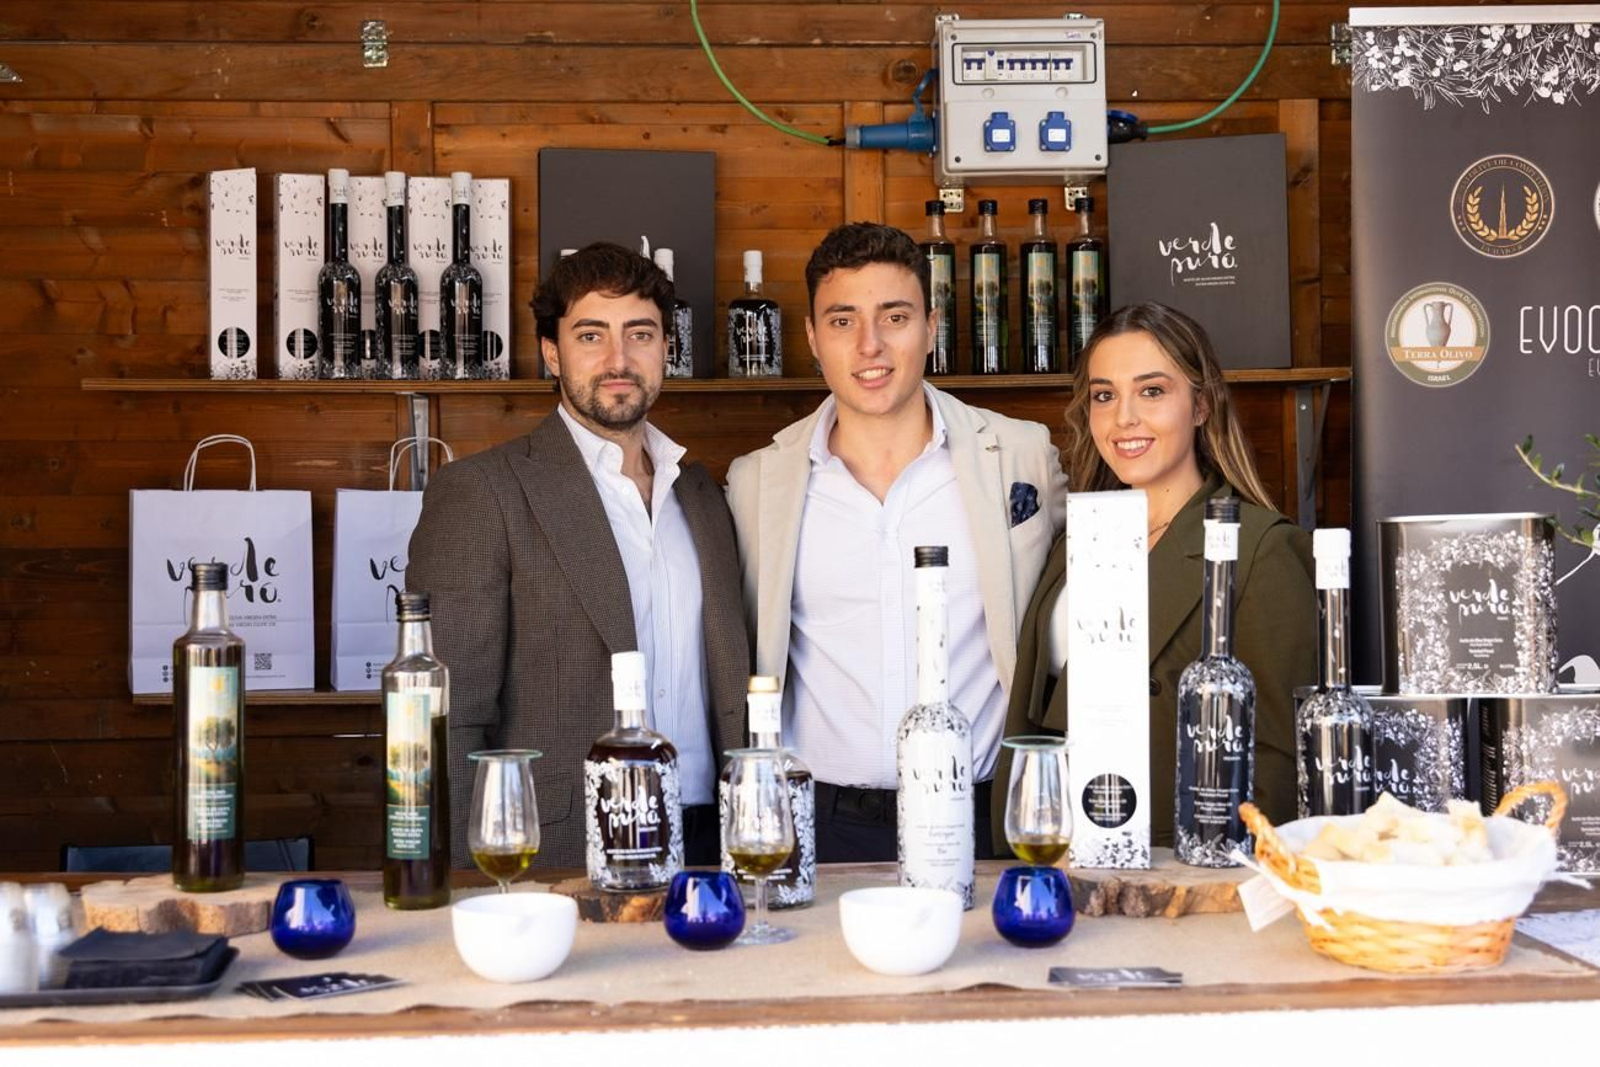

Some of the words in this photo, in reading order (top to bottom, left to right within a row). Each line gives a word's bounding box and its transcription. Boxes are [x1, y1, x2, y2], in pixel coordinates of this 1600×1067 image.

[1159, 222, 1237, 256] verde
[1403, 349, 1437, 359] TERRA
[1439, 349, 1473, 359] OLIVO
[167, 537, 280, 582] vede
[1449, 578, 1510, 603] verde
[1187, 714, 1244, 740] verde
[601, 786, 658, 813] verde
